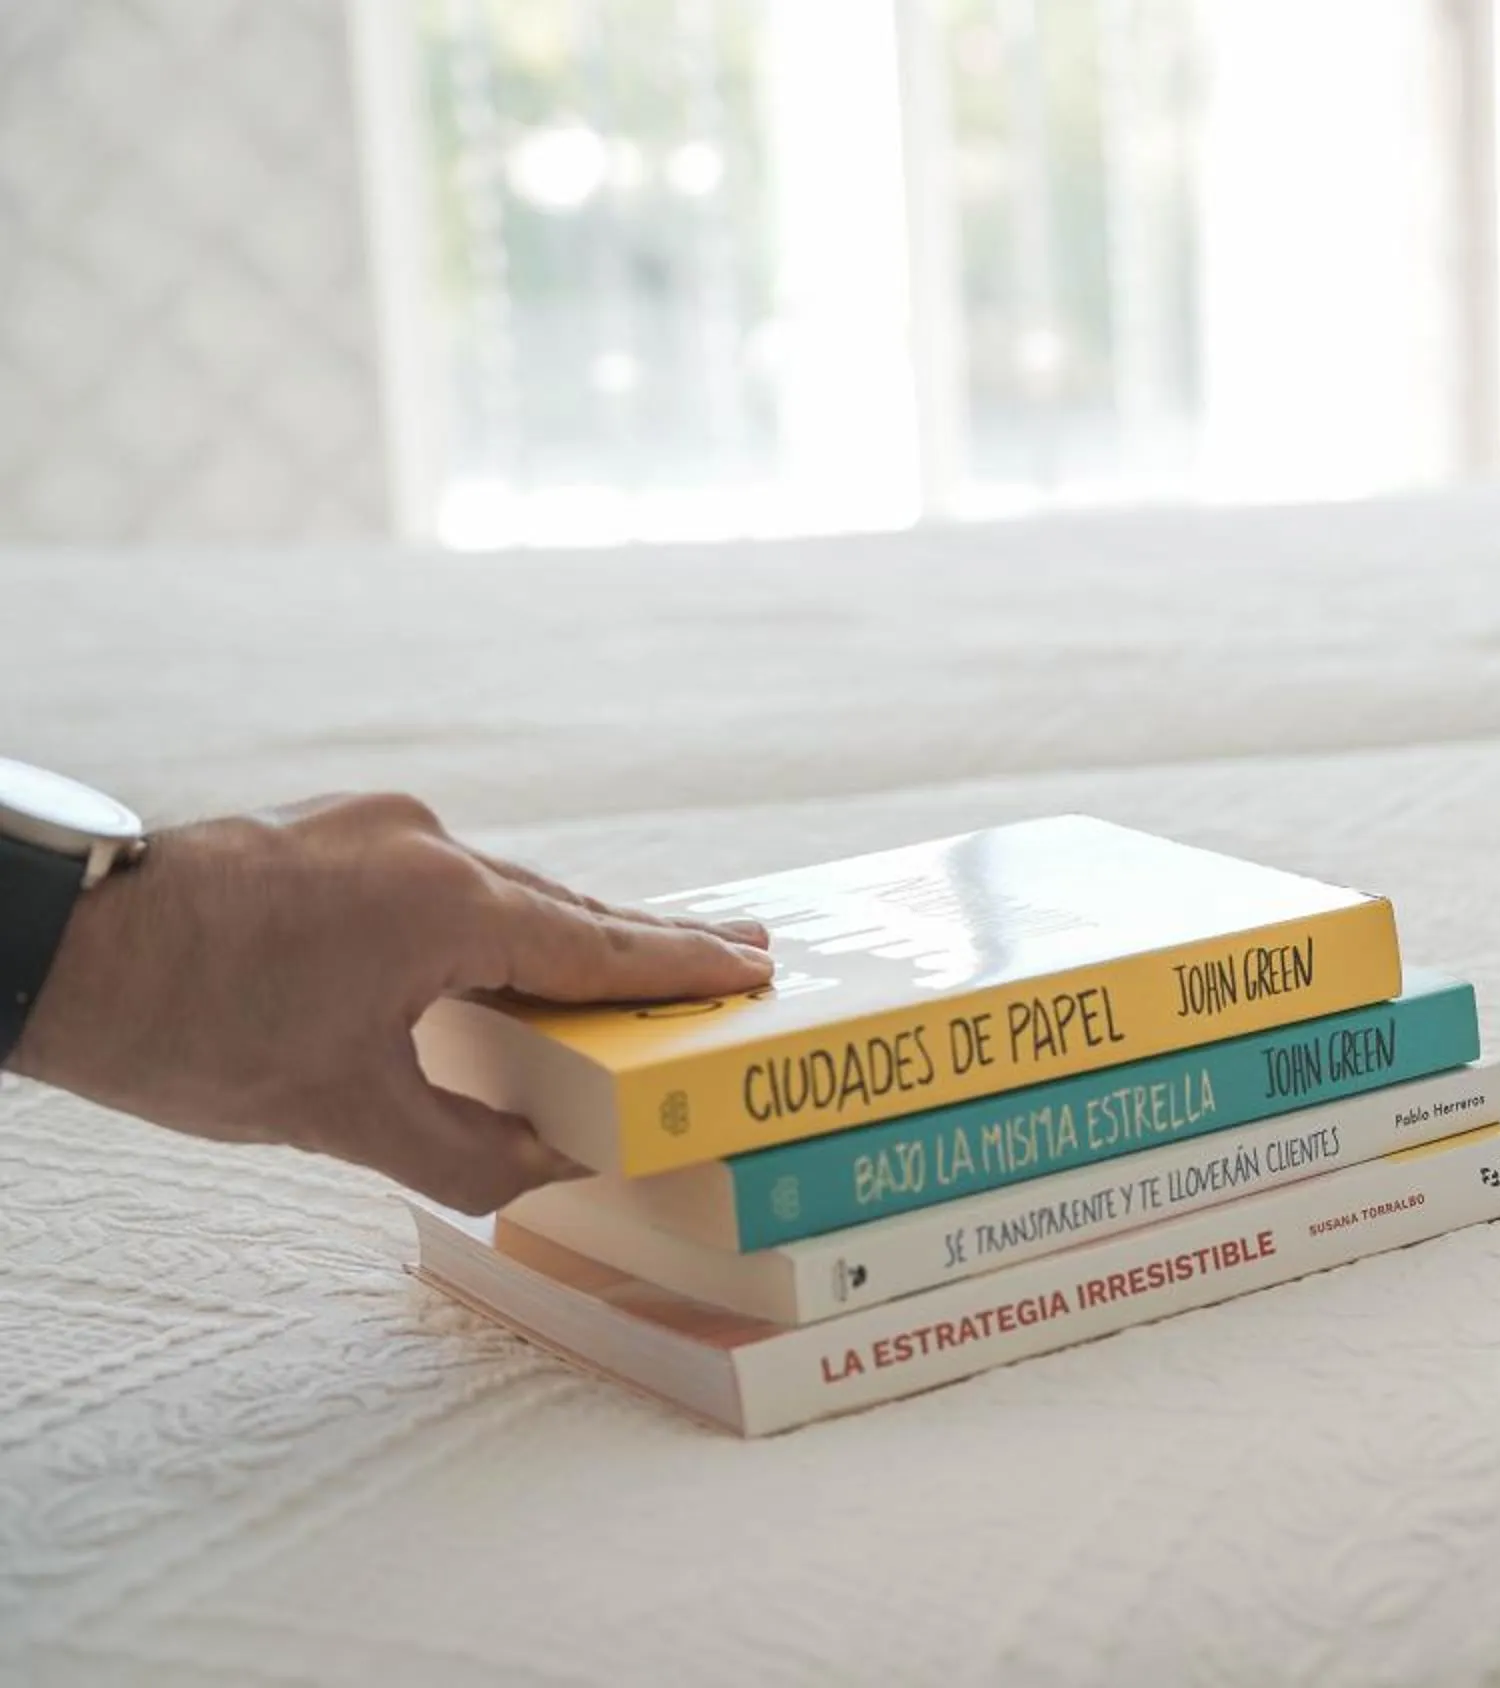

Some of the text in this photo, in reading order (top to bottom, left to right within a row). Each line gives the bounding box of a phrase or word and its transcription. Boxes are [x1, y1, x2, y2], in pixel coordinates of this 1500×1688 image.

[1172, 936, 1314, 1017] JOHN GREEN
[744, 986, 1125, 1122] CIUDADES DE PAPEL
[1261, 1018, 1396, 1099] JOHN GREEN
[853, 1067, 1216, 1204] BAJO LA MISMA ESTRELLA
[1395, 1095, 1486, 1128] Pablo Herreros
[943, 1126, 1340, 1268] SÉ TRANSPARENTE Y TE LLOVERÁN CLIENTES
[1308, 1192, 1426, 1237] SUSANA TORRALBO
[821, 1230, 1277, 1384] LA ESTRATEGIA IRRESISTIBLE
